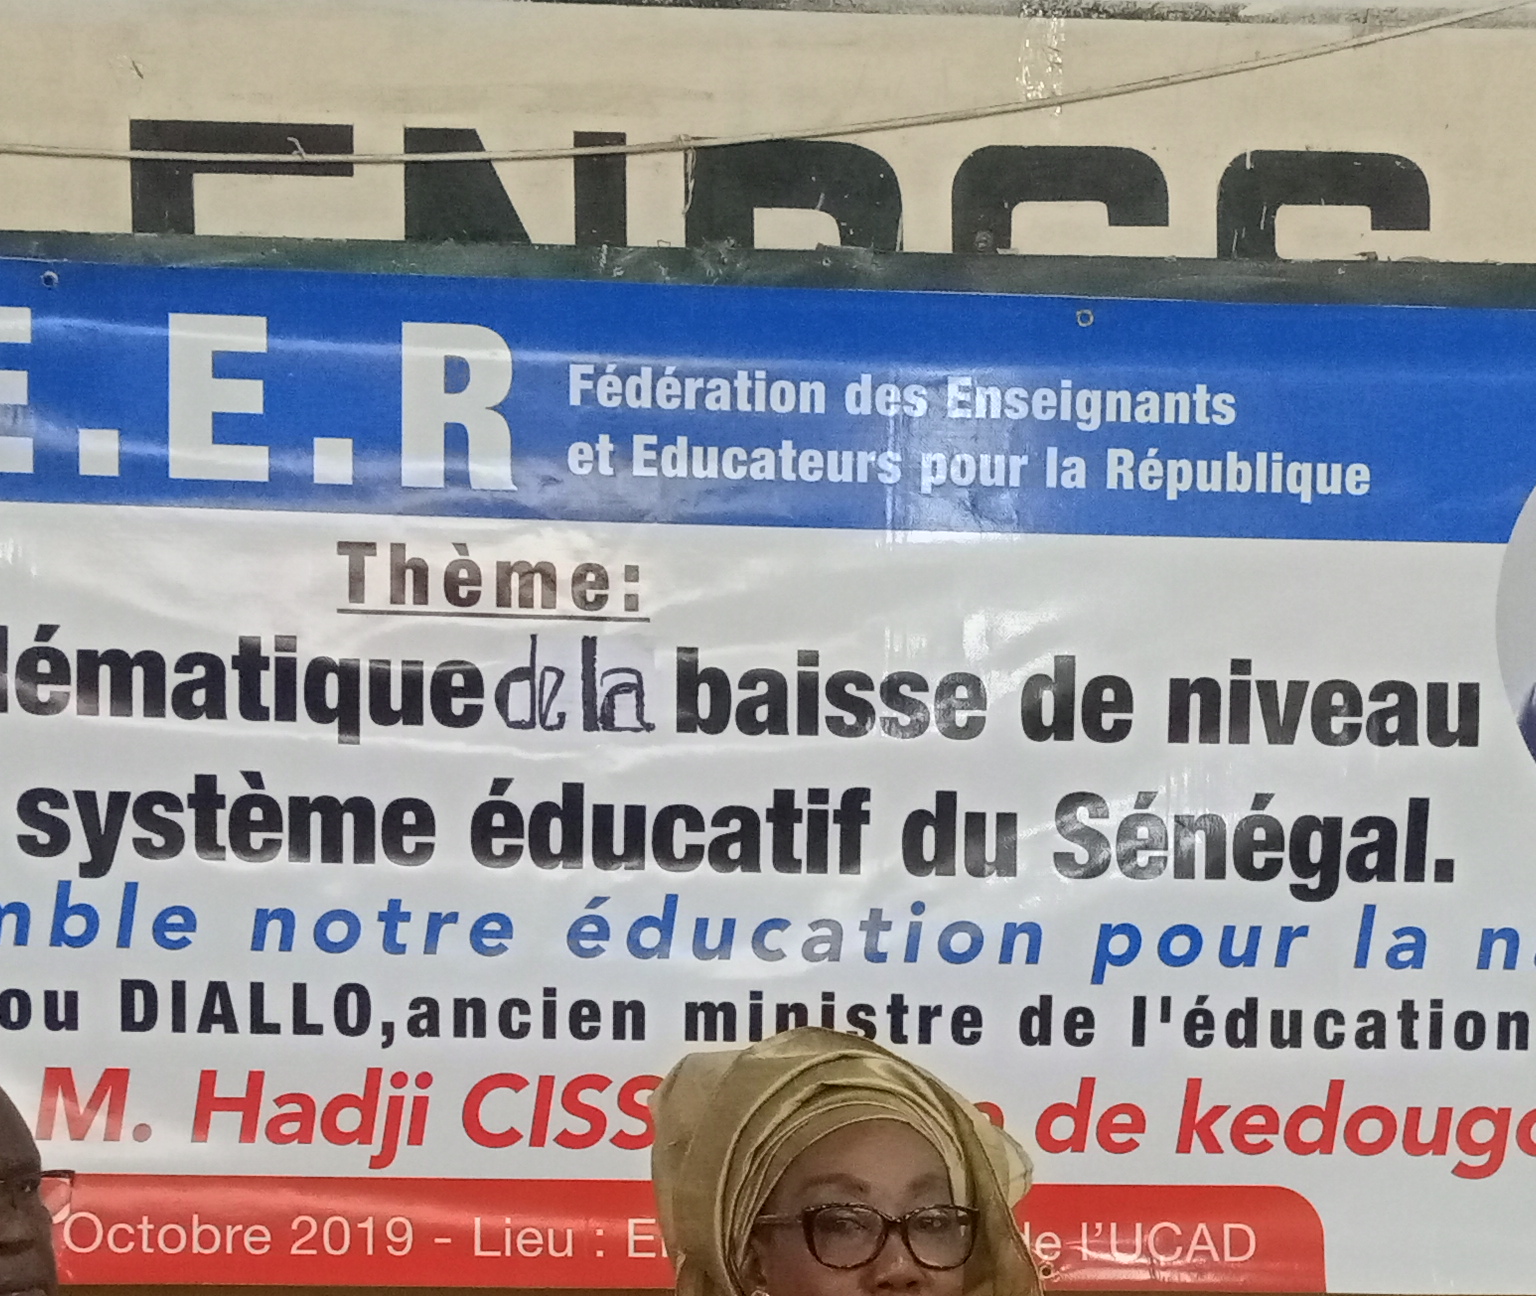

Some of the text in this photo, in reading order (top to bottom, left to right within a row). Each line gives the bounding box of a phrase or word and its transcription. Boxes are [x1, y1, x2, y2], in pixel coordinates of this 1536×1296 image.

[569, 363, 1236, 431] Fédération des Enseignants
[569, 433, 1371, 503] et Educateurs pour la République
[337, 541, 640, 610] Thème:
[495, 635, 565, 733] de
[581, 635, 655, 734] la
[676, 647, 988, 740] baisse
[1022, 656, 1134, 743] de
[1167, 658, 1480, 747] niveau
[17, 771, 435, 878] système
[471, 777, 869, 875] éducatif
[902, 791, 1017, 877] du
[1053, 791, 1455, 902] Sénégal.
[251, 893, 513, 957] notre
[566, 894, 1042, 965] éducation
[1090, 917, 1308, 984] pour
[1354, 905, 1426, 970] la
[120, 978, 645, 1047] DIALLO,ancien
[685, 990, 982, 1045] ministre
[1019, 995, 1094, 1046] de
[1131, 993, 1529, 1051] l'éducation
[35, 1066, 152, 1142] M.
[190, 1067, 433, 1169] Hadji
[462, 1073, 664, 1150] CISS
[1035, 1077, 1146, 1154] de
[63, 1211, 270, 1254] Octobre
[290, 1215, 413, 1256] 2019
[473, 1216, 574, 1258] Lieu
